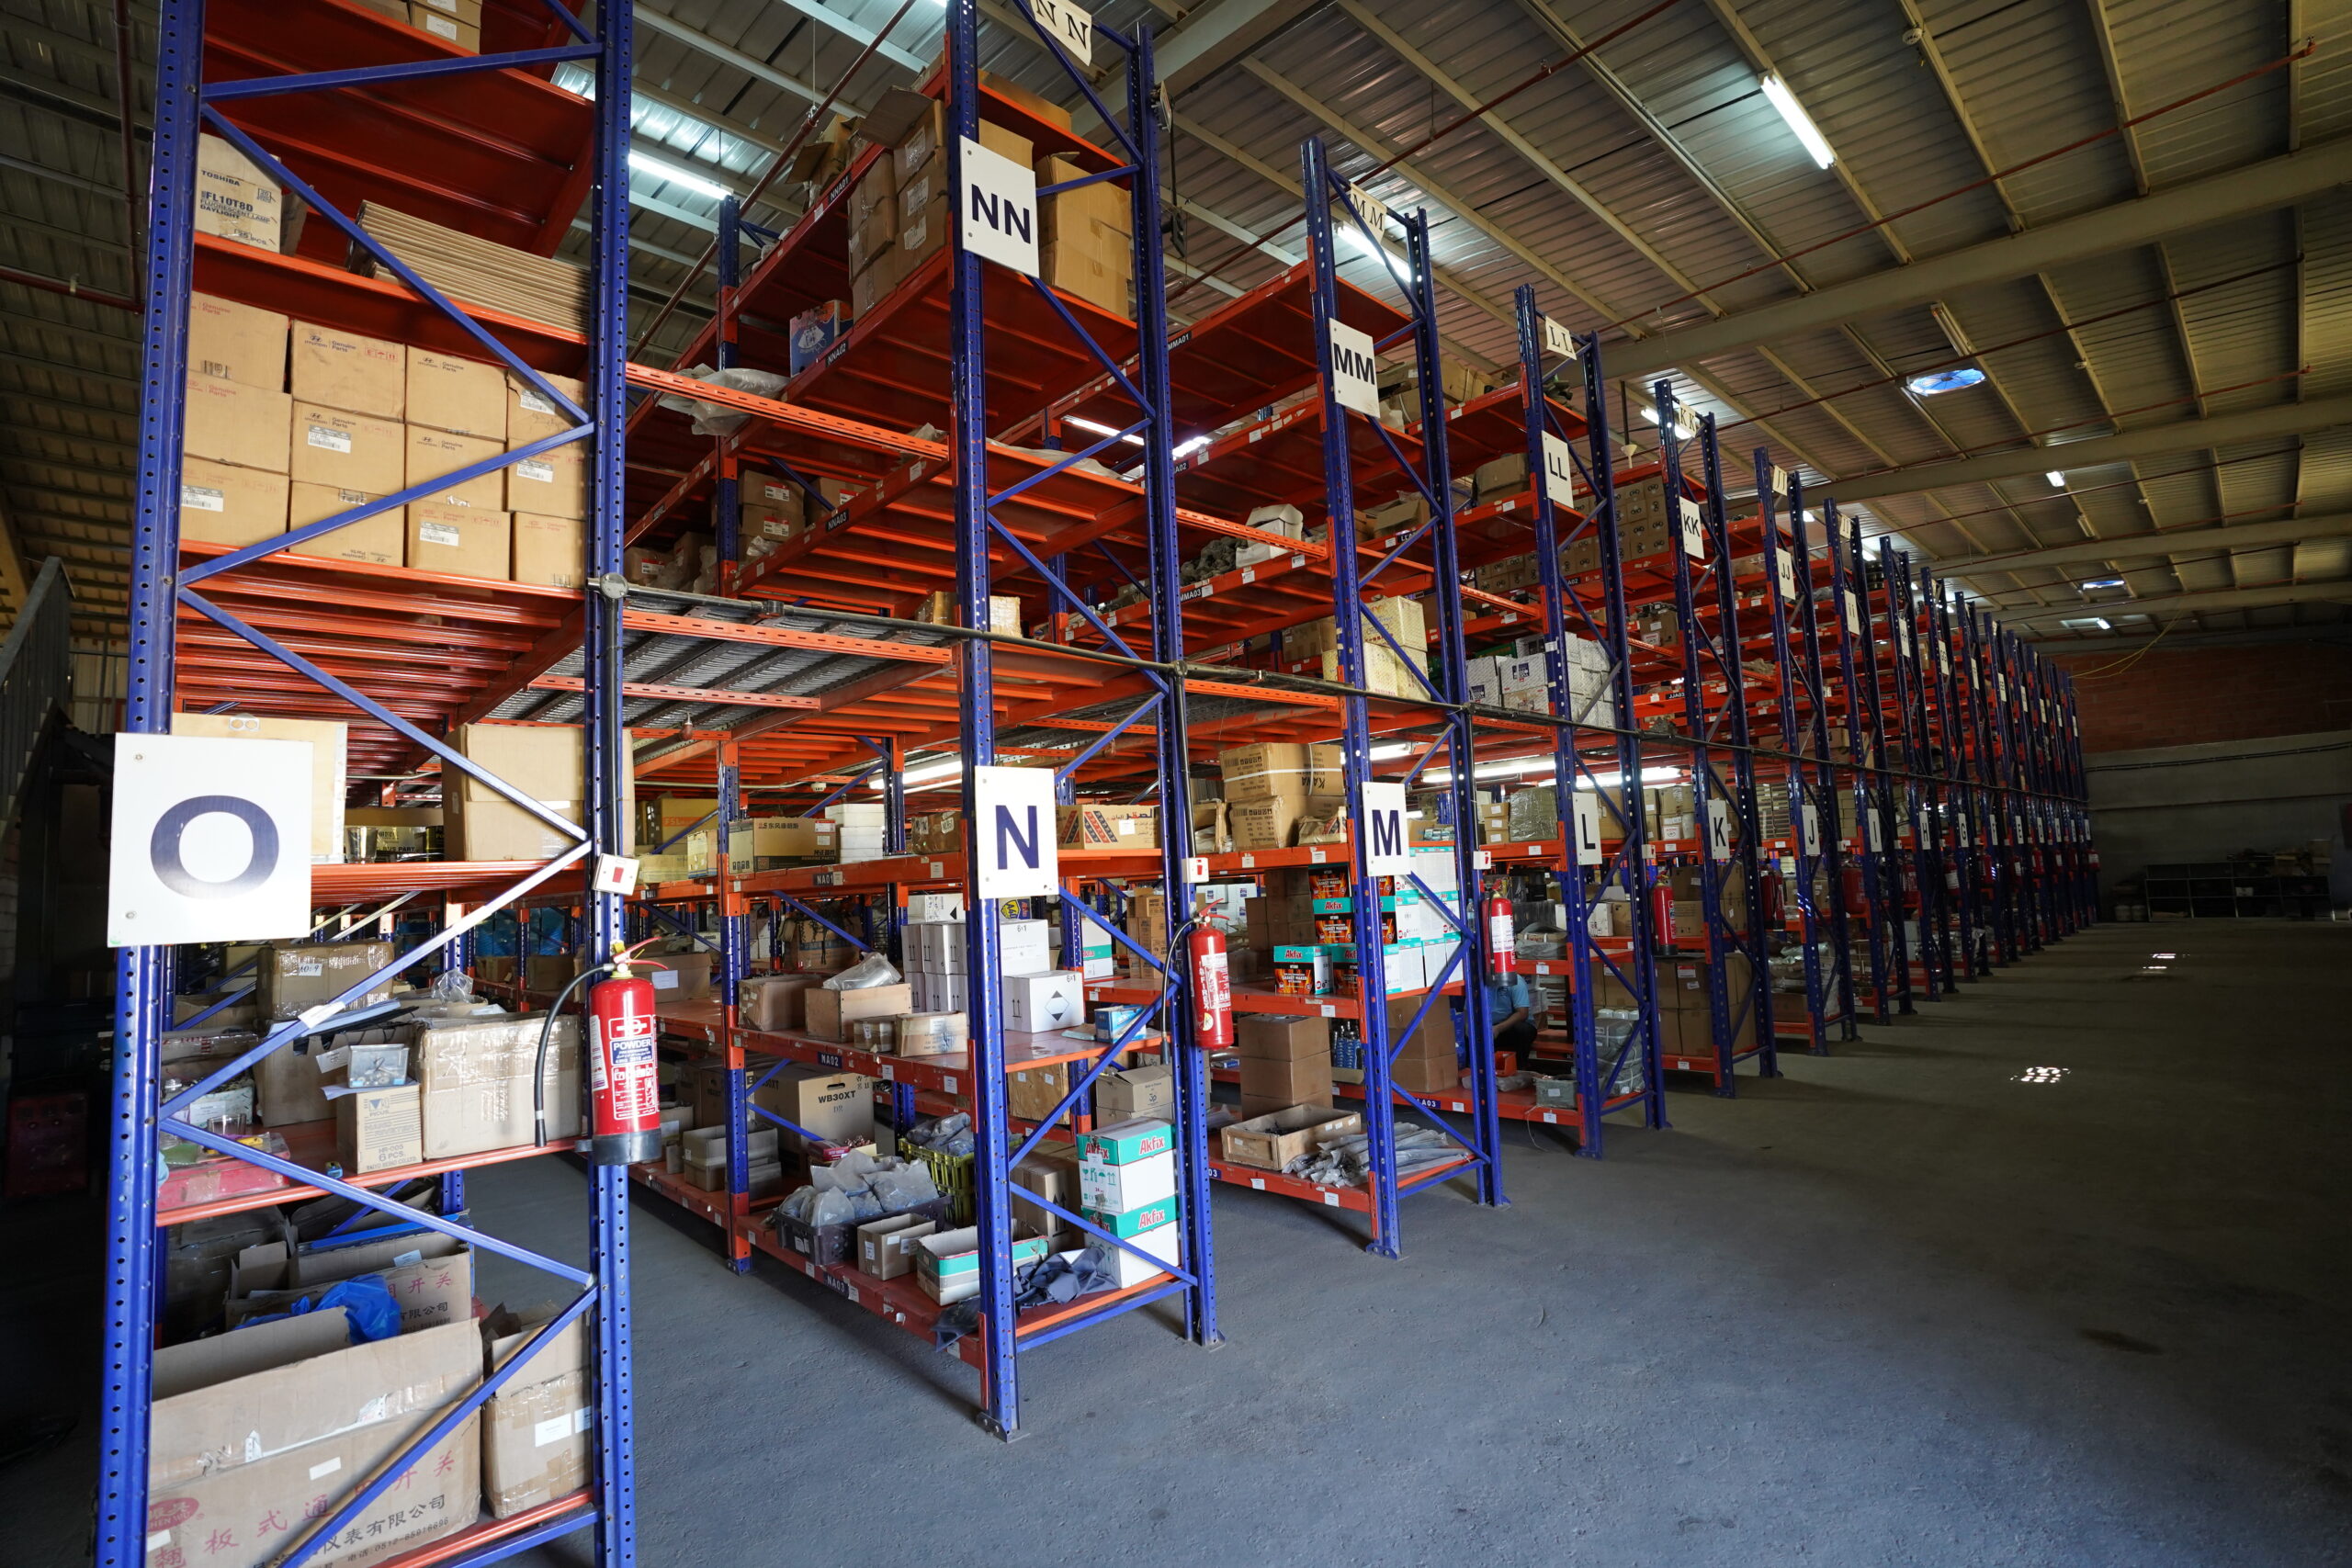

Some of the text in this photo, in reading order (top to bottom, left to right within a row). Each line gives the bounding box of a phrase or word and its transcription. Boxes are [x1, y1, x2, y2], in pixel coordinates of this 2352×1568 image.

[201, 169, 241, 186] TOSHIBA
[830, 175, 849, 200] NNA01
[206, 191, 254, 212] FL10T8D
[200, 204, 240, 220] DAYLIGHT
[971, 183, 1031, 244] NN
[202, 302, 231, 314] Genuine
[332, 340, 356, 350] Genuine
[1168, 333, 1190, 351] MMA01
[828, 343, 846, 365] NNA02
[442, 361, 464, 370] Genuine
[1333, 343, 1375, 386] MM
[332, 417, 356, 426] Genuine
[1548, 452, 1567, 481] LL
[828, 512, 847, 530] NNA03
[1683, 513, 1700, 537] KK
[1781, 563, 1791, 581] JJ
[995, 805, 1040, 870] N
[1372, 809, 1402, 856] M
[1581, 814, 1596, 850] L
[1713, 817, 1726, 847] K
[1808, 818, 1816, 845] J
[1921, 823, 1929, 841] H
[1961, 823, 1967, 840] G
[150, 795, 279, 898] O
[817, 874, 834, 885] NA01
[1325, 901, 1342, 910] Akfix
[1284, 950, 1303, 959] Akfix
[1344, 950, 1358, 959] Akf
[613, 1038, 651, 1051] POWDER
[820, 1054, 839, 1066] NA02
[818, 1089, 856, 1103] WB30XT
[1417, 1099, 1436, 1108] A03
[1139, 1136, 1165, 1155] Akfix
[1138, 1209, 1165, 1230] Akfix
[827, 1279, 845, 1292] NA03
